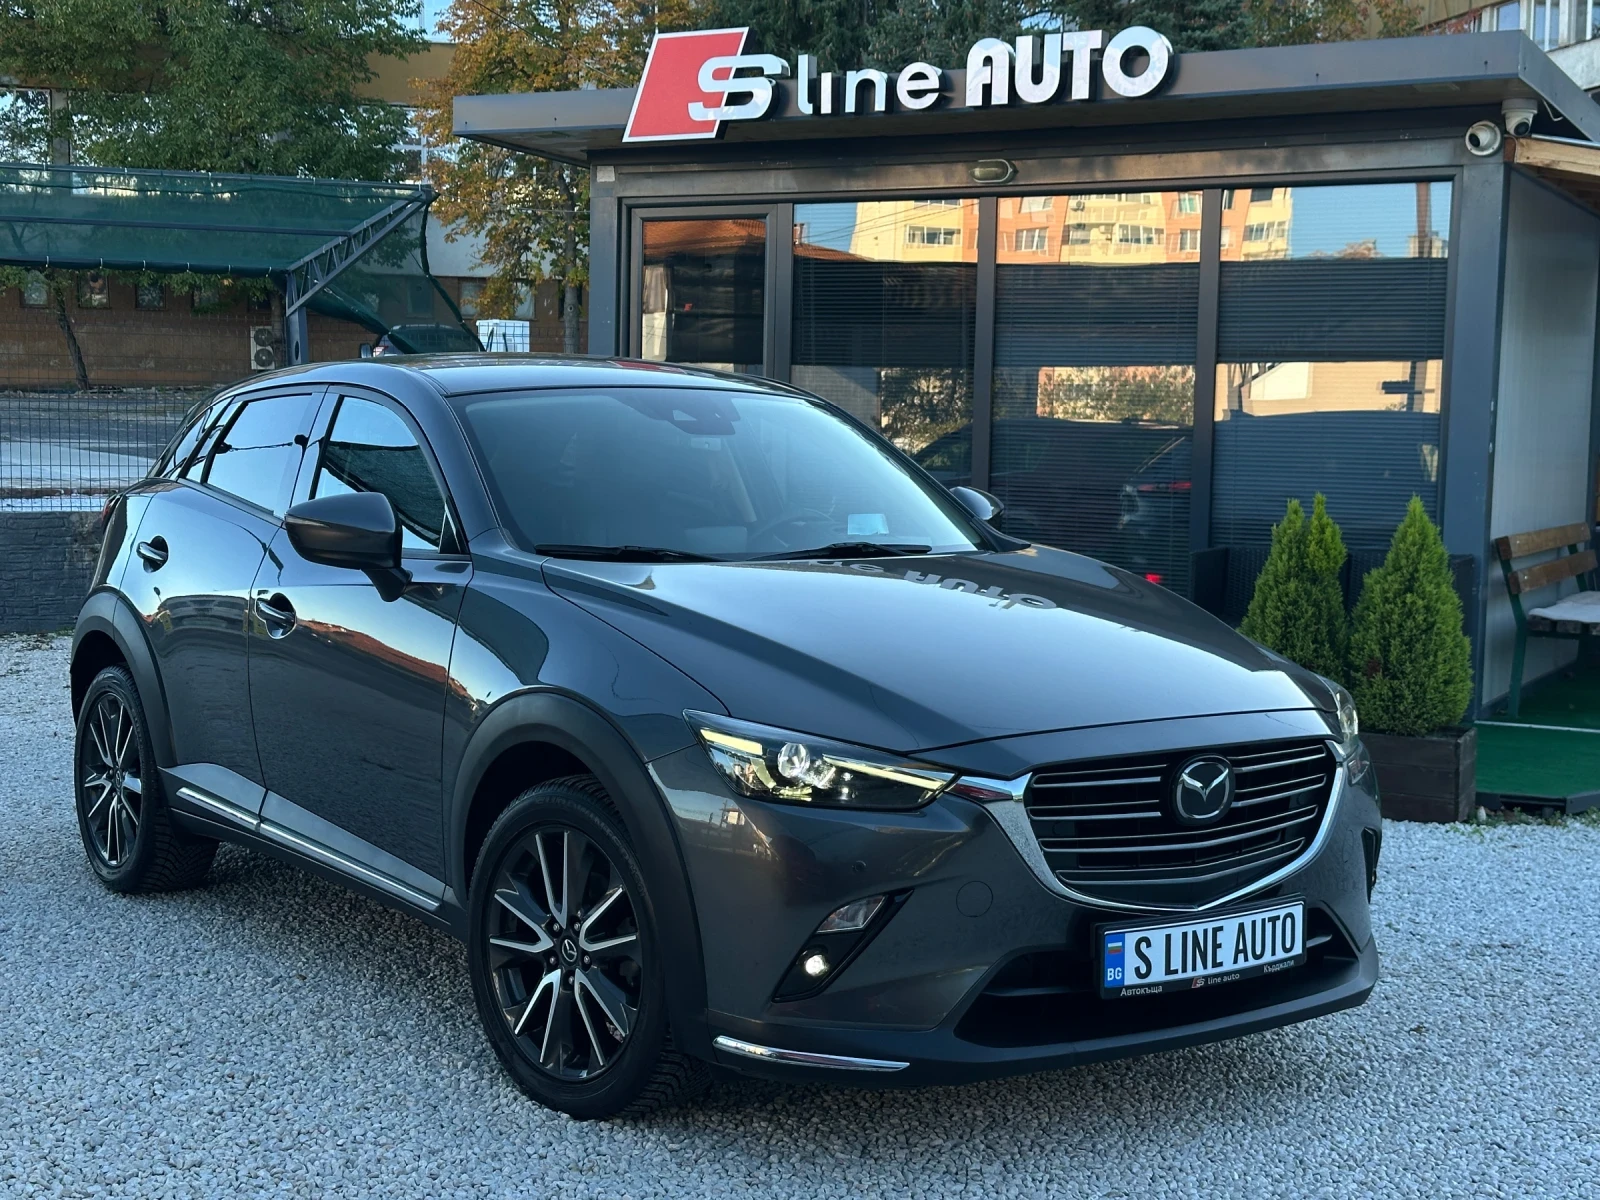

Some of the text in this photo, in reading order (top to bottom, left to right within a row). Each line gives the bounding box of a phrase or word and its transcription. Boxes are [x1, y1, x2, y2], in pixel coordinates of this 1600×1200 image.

[688, 26, 1172, 121] S line AUTO
[1134, 912, 1296, 979] S LINE AUTO
[1263, 960, 1294, 973] Кърджали
[1107, 967, 1122, 980] BG
[1208, 976, 1221, 984] line
[1223, 973, 1240, 981] auto
[1120, 986, 1162, 996] Автокъща
